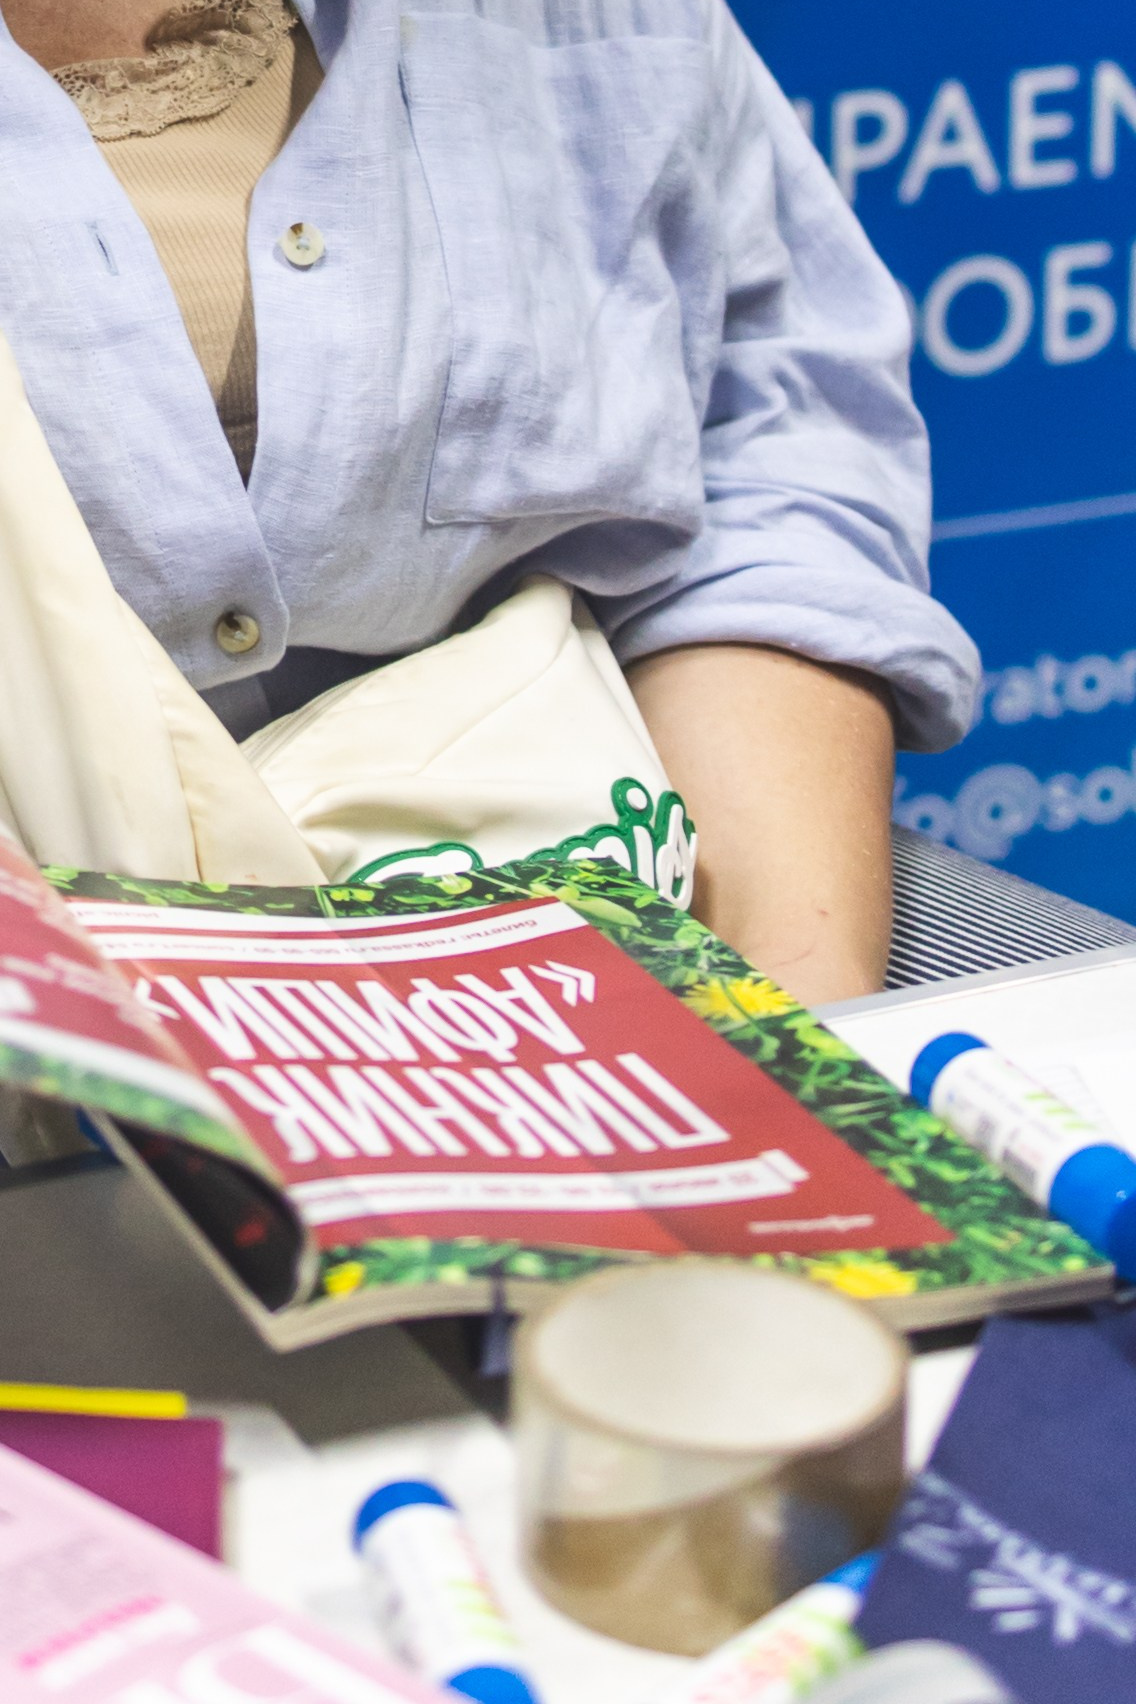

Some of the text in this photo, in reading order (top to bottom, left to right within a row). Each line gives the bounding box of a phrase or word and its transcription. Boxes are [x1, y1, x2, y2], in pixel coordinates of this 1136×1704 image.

[792, 59, 1136, 207] РАЕ
[894, 240, 1136, 378] ОБ
[208, 1052, 731, 1163] ПИКНИК
